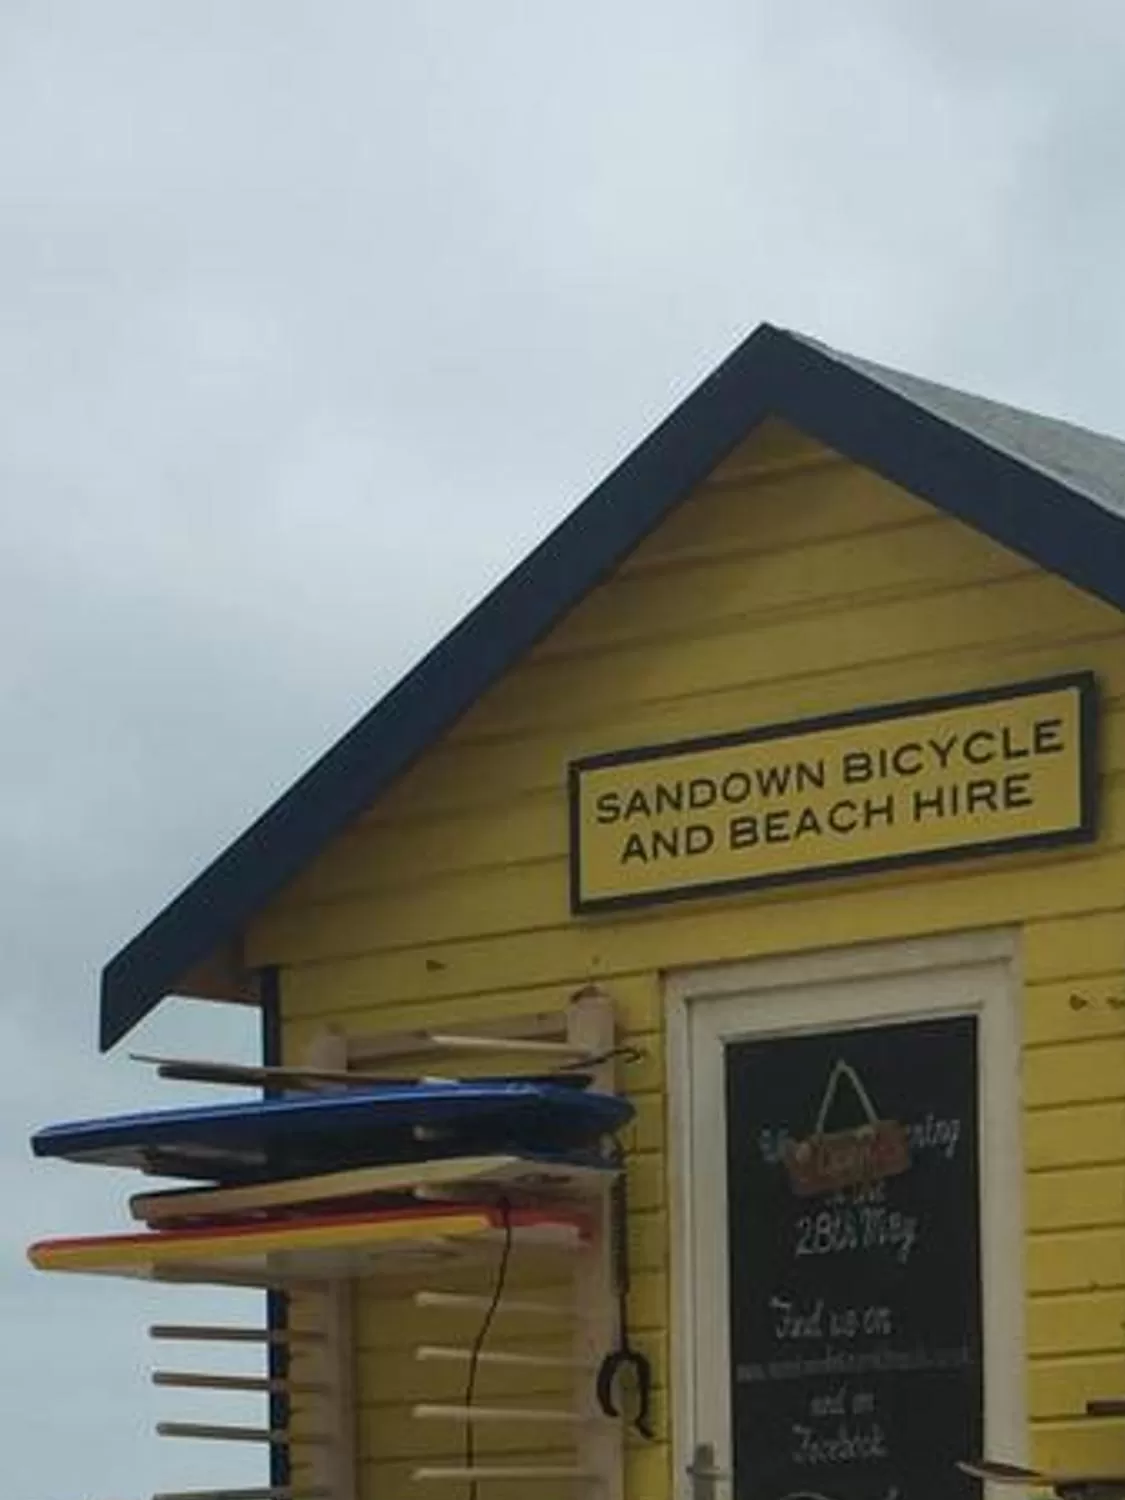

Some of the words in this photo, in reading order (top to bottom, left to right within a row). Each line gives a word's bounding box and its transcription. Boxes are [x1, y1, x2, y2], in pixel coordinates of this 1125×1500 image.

[596, 760, 825, 825] SANDOWN
[843, 718, 1064, 784] BICYCLE
[620, 825, 714, 865] AND
[729, 796, 895, 850] BEACH
[913, 772, 1034, 823] HIRE
